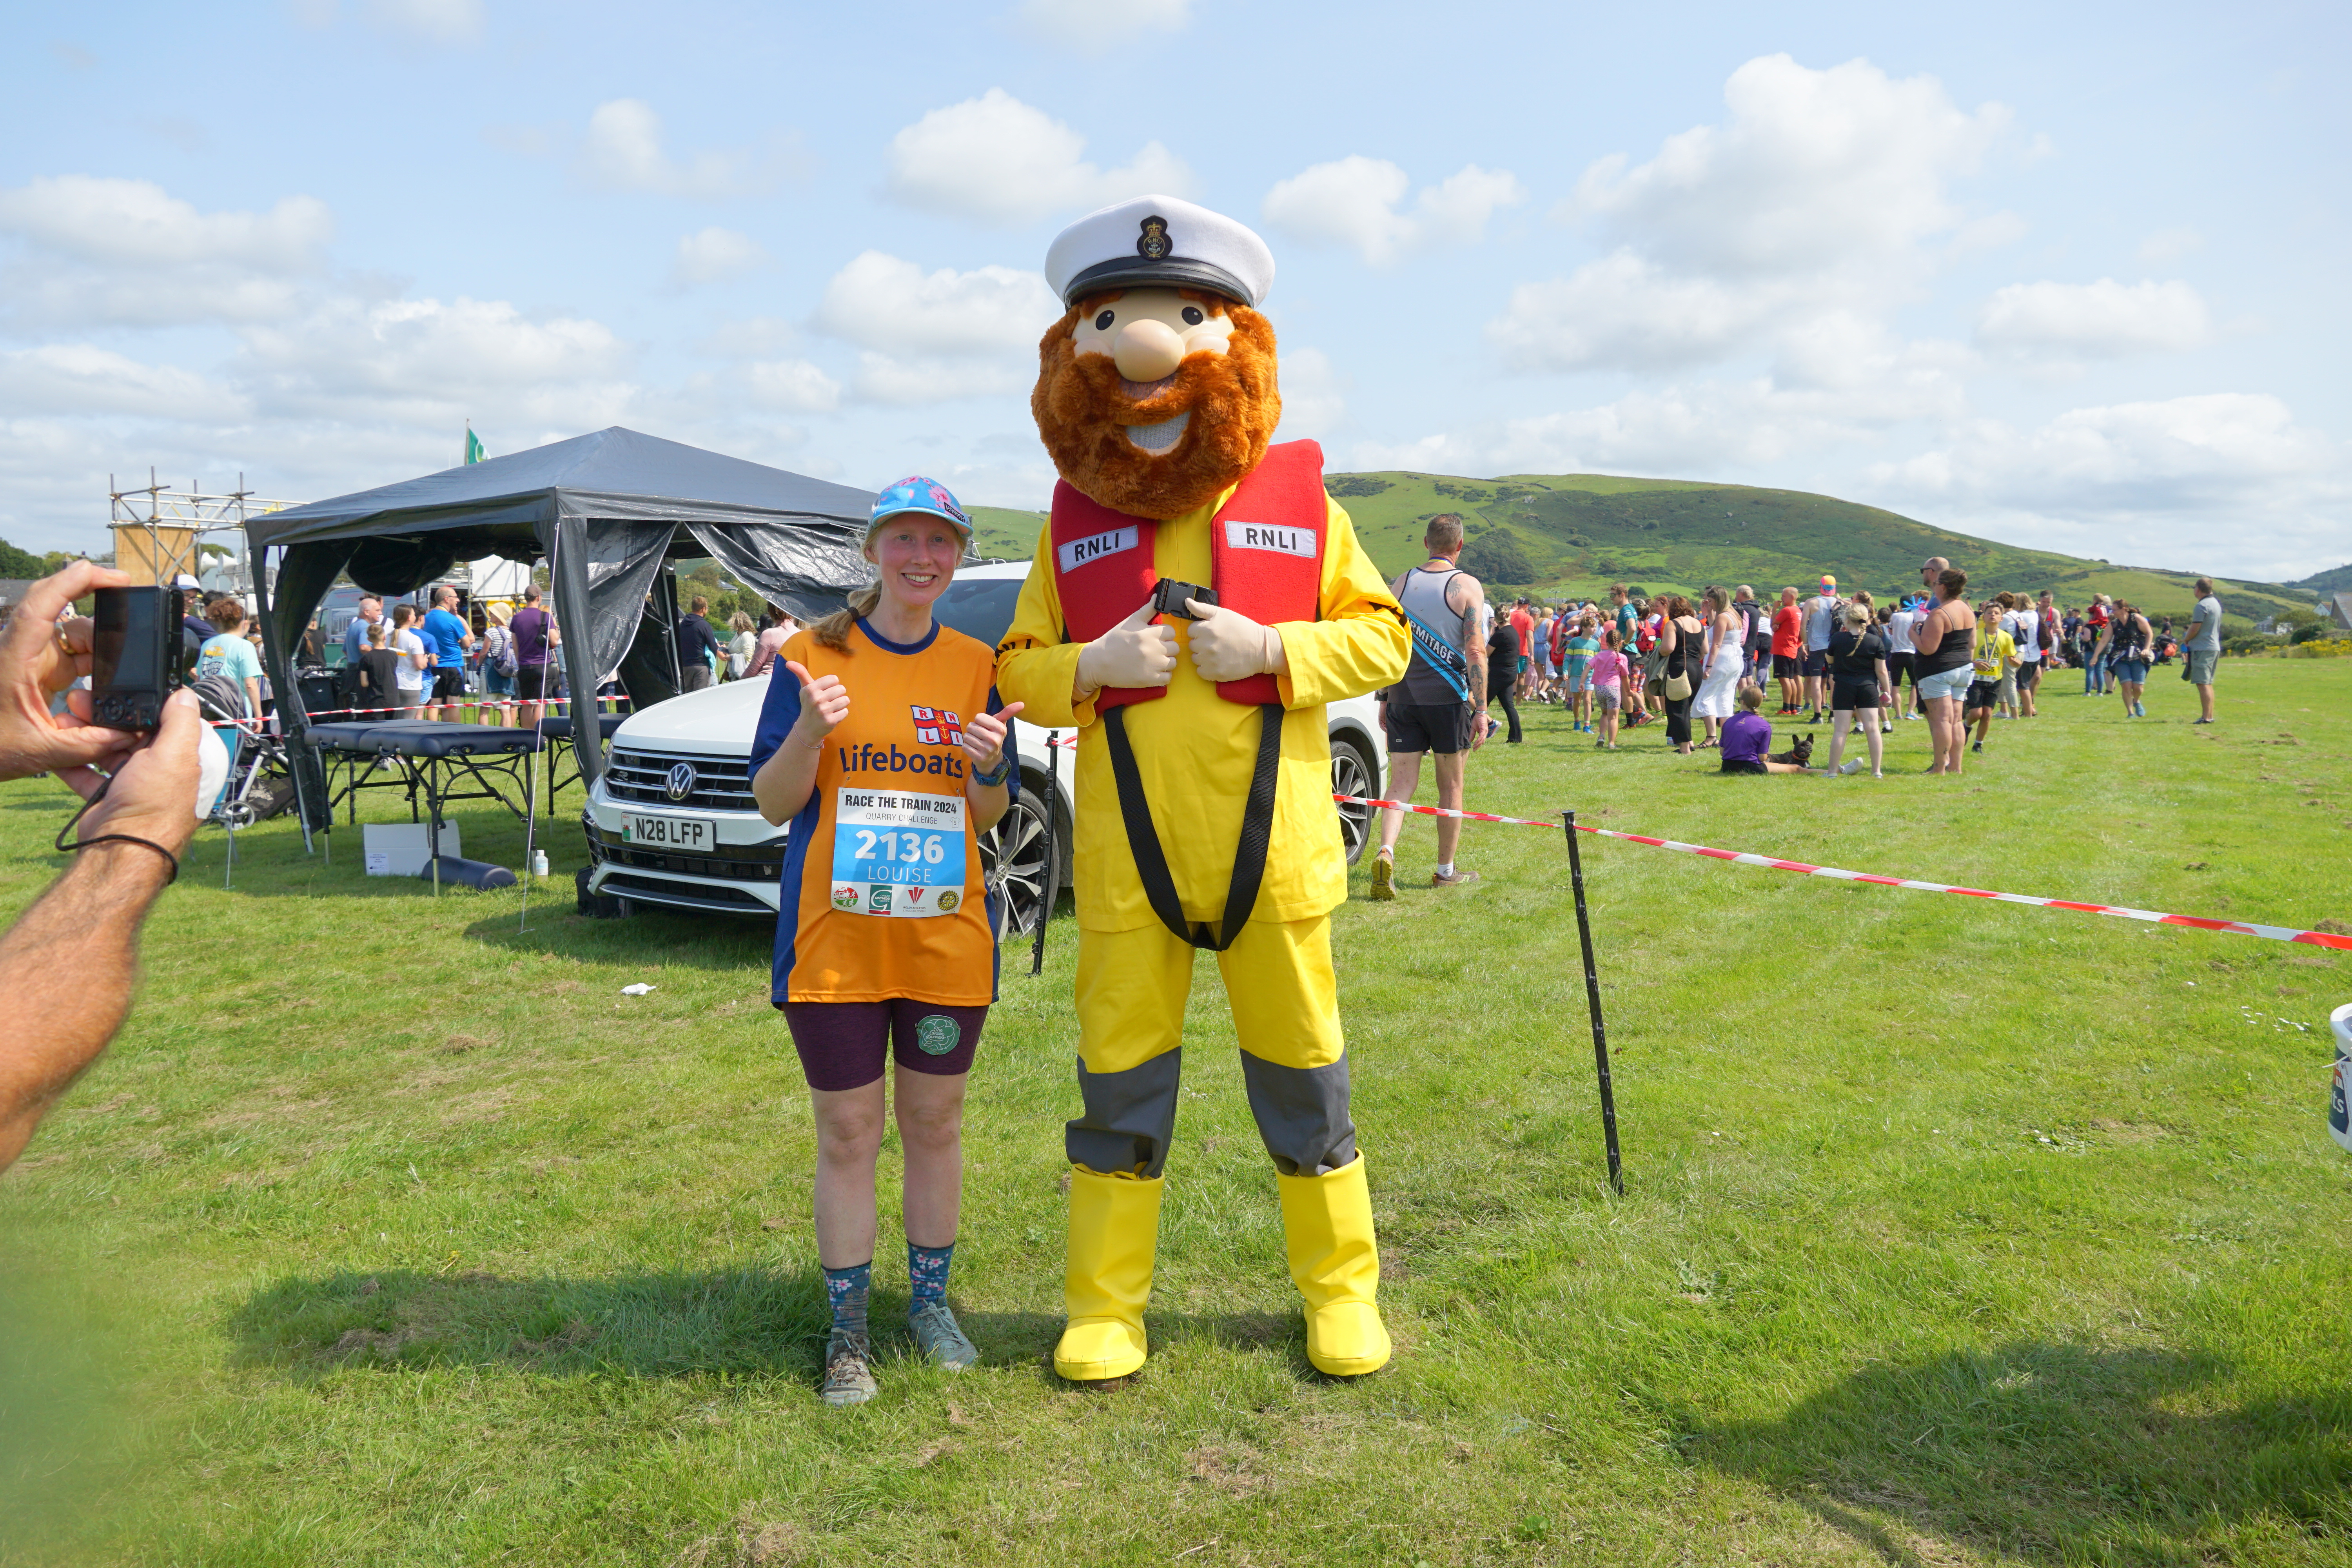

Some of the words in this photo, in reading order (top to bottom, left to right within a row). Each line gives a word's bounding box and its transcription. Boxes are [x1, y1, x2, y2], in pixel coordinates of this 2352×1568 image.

[1075, 532, 1119, 562] RNLI
[1246, 528, 1296, 550] RNLI
[1408, 617, 1455, 665] RMITAGE
[840, 743, 963, 778] Lifeboats
[845, 795, 874, 807] RACE
[878, 797, 897, 808] THE
[901, 798, 931, 811] TRAIN
[934, 801, 956, 814] 2024
[636, 818, 666, 842] N28
[670, 822, 703, 845] LFP
[866, 813, 897, 821] QUARRY
[898, 814, 938, 824] CHALLENGE
[855, 830, 944, 864] 2136
[868, 866, 932, 883] LOUISE
